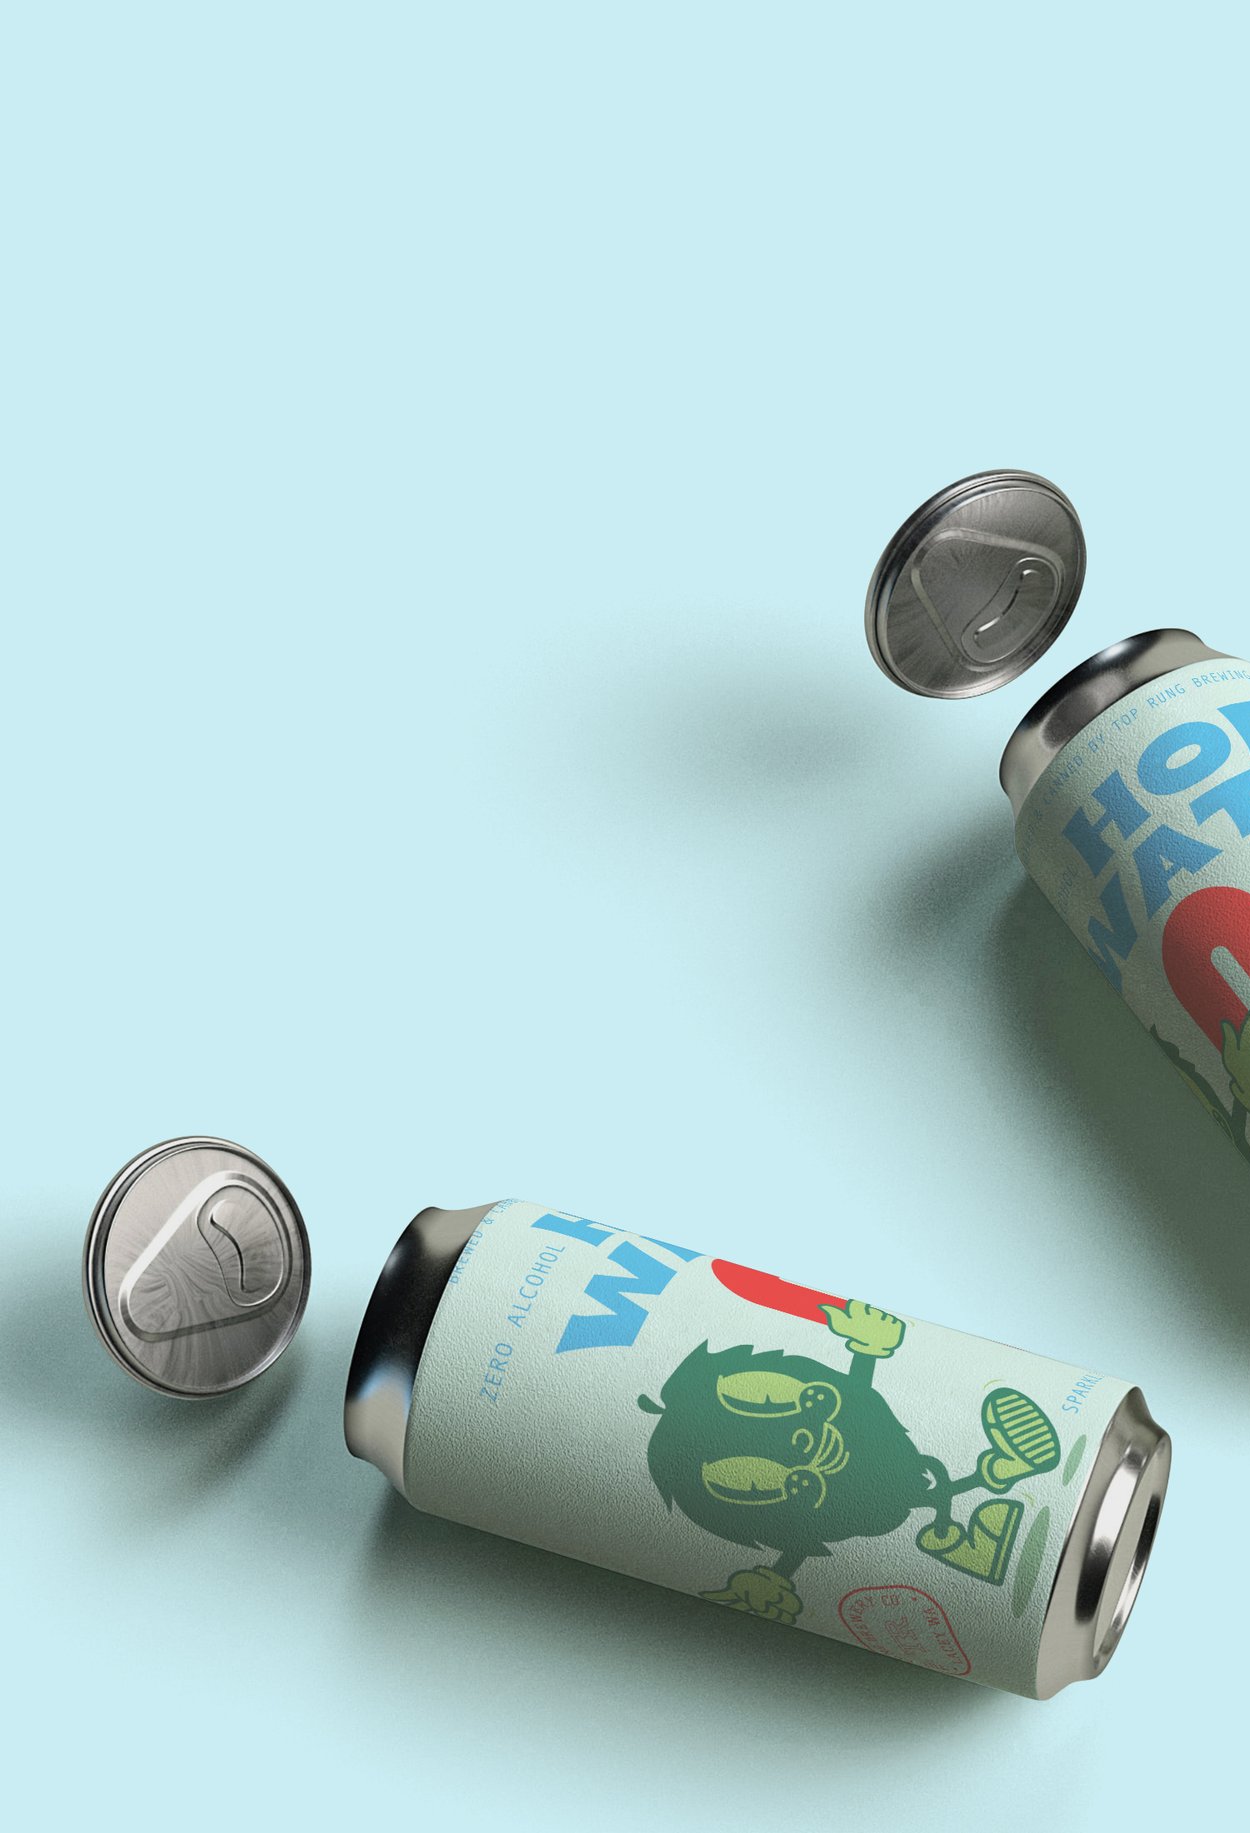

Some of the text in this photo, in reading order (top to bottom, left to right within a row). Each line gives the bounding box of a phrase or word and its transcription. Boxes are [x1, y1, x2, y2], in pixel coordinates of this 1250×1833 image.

[1111, 708, 1139, 731] TOP
[1146, 683, 1186, 709] RUNG
[449, 1230, 484, 1285] BREWED
[480, 1245, 566, 1402] ZERO ALCOHOL
